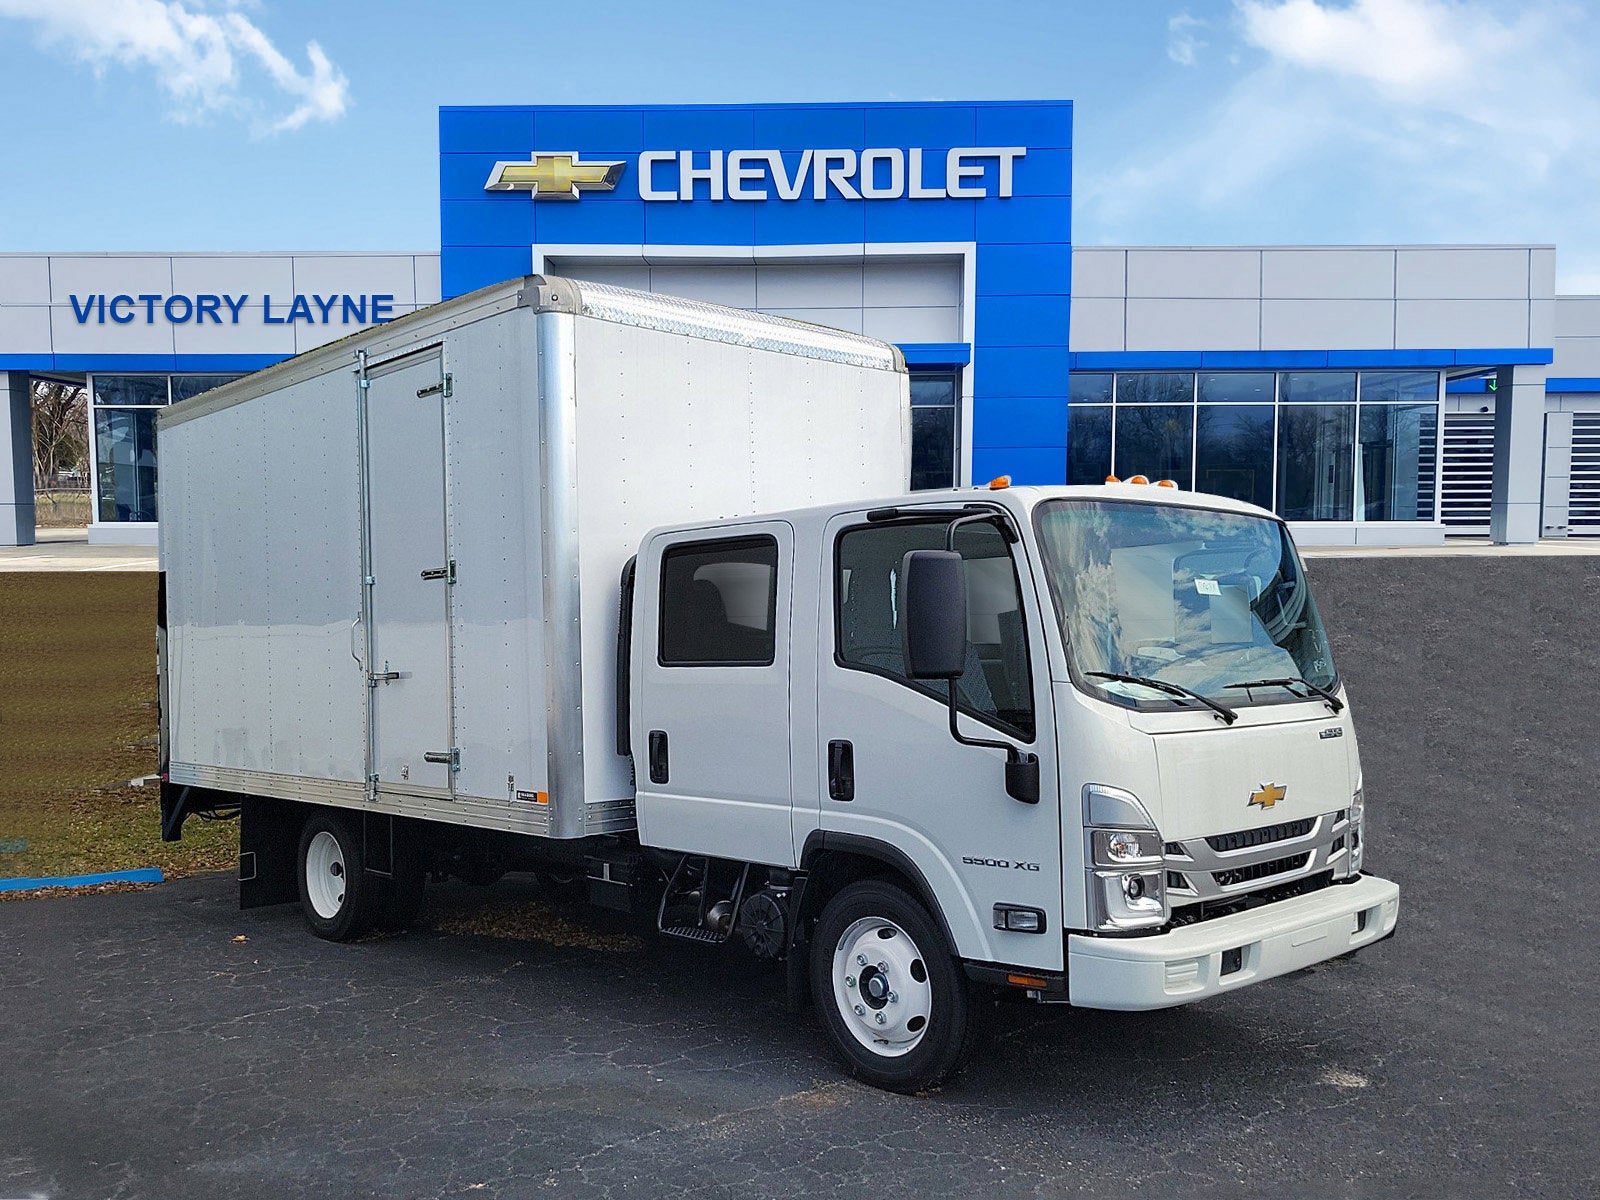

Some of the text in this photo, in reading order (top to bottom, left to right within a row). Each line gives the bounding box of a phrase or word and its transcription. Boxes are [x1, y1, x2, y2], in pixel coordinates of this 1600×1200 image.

[638, 146, 1027, 201] CHEVROLET
[69, 294, 394, 325] VICTORY LAYNE
[962, 856, 1040, 872] 5500 XG
